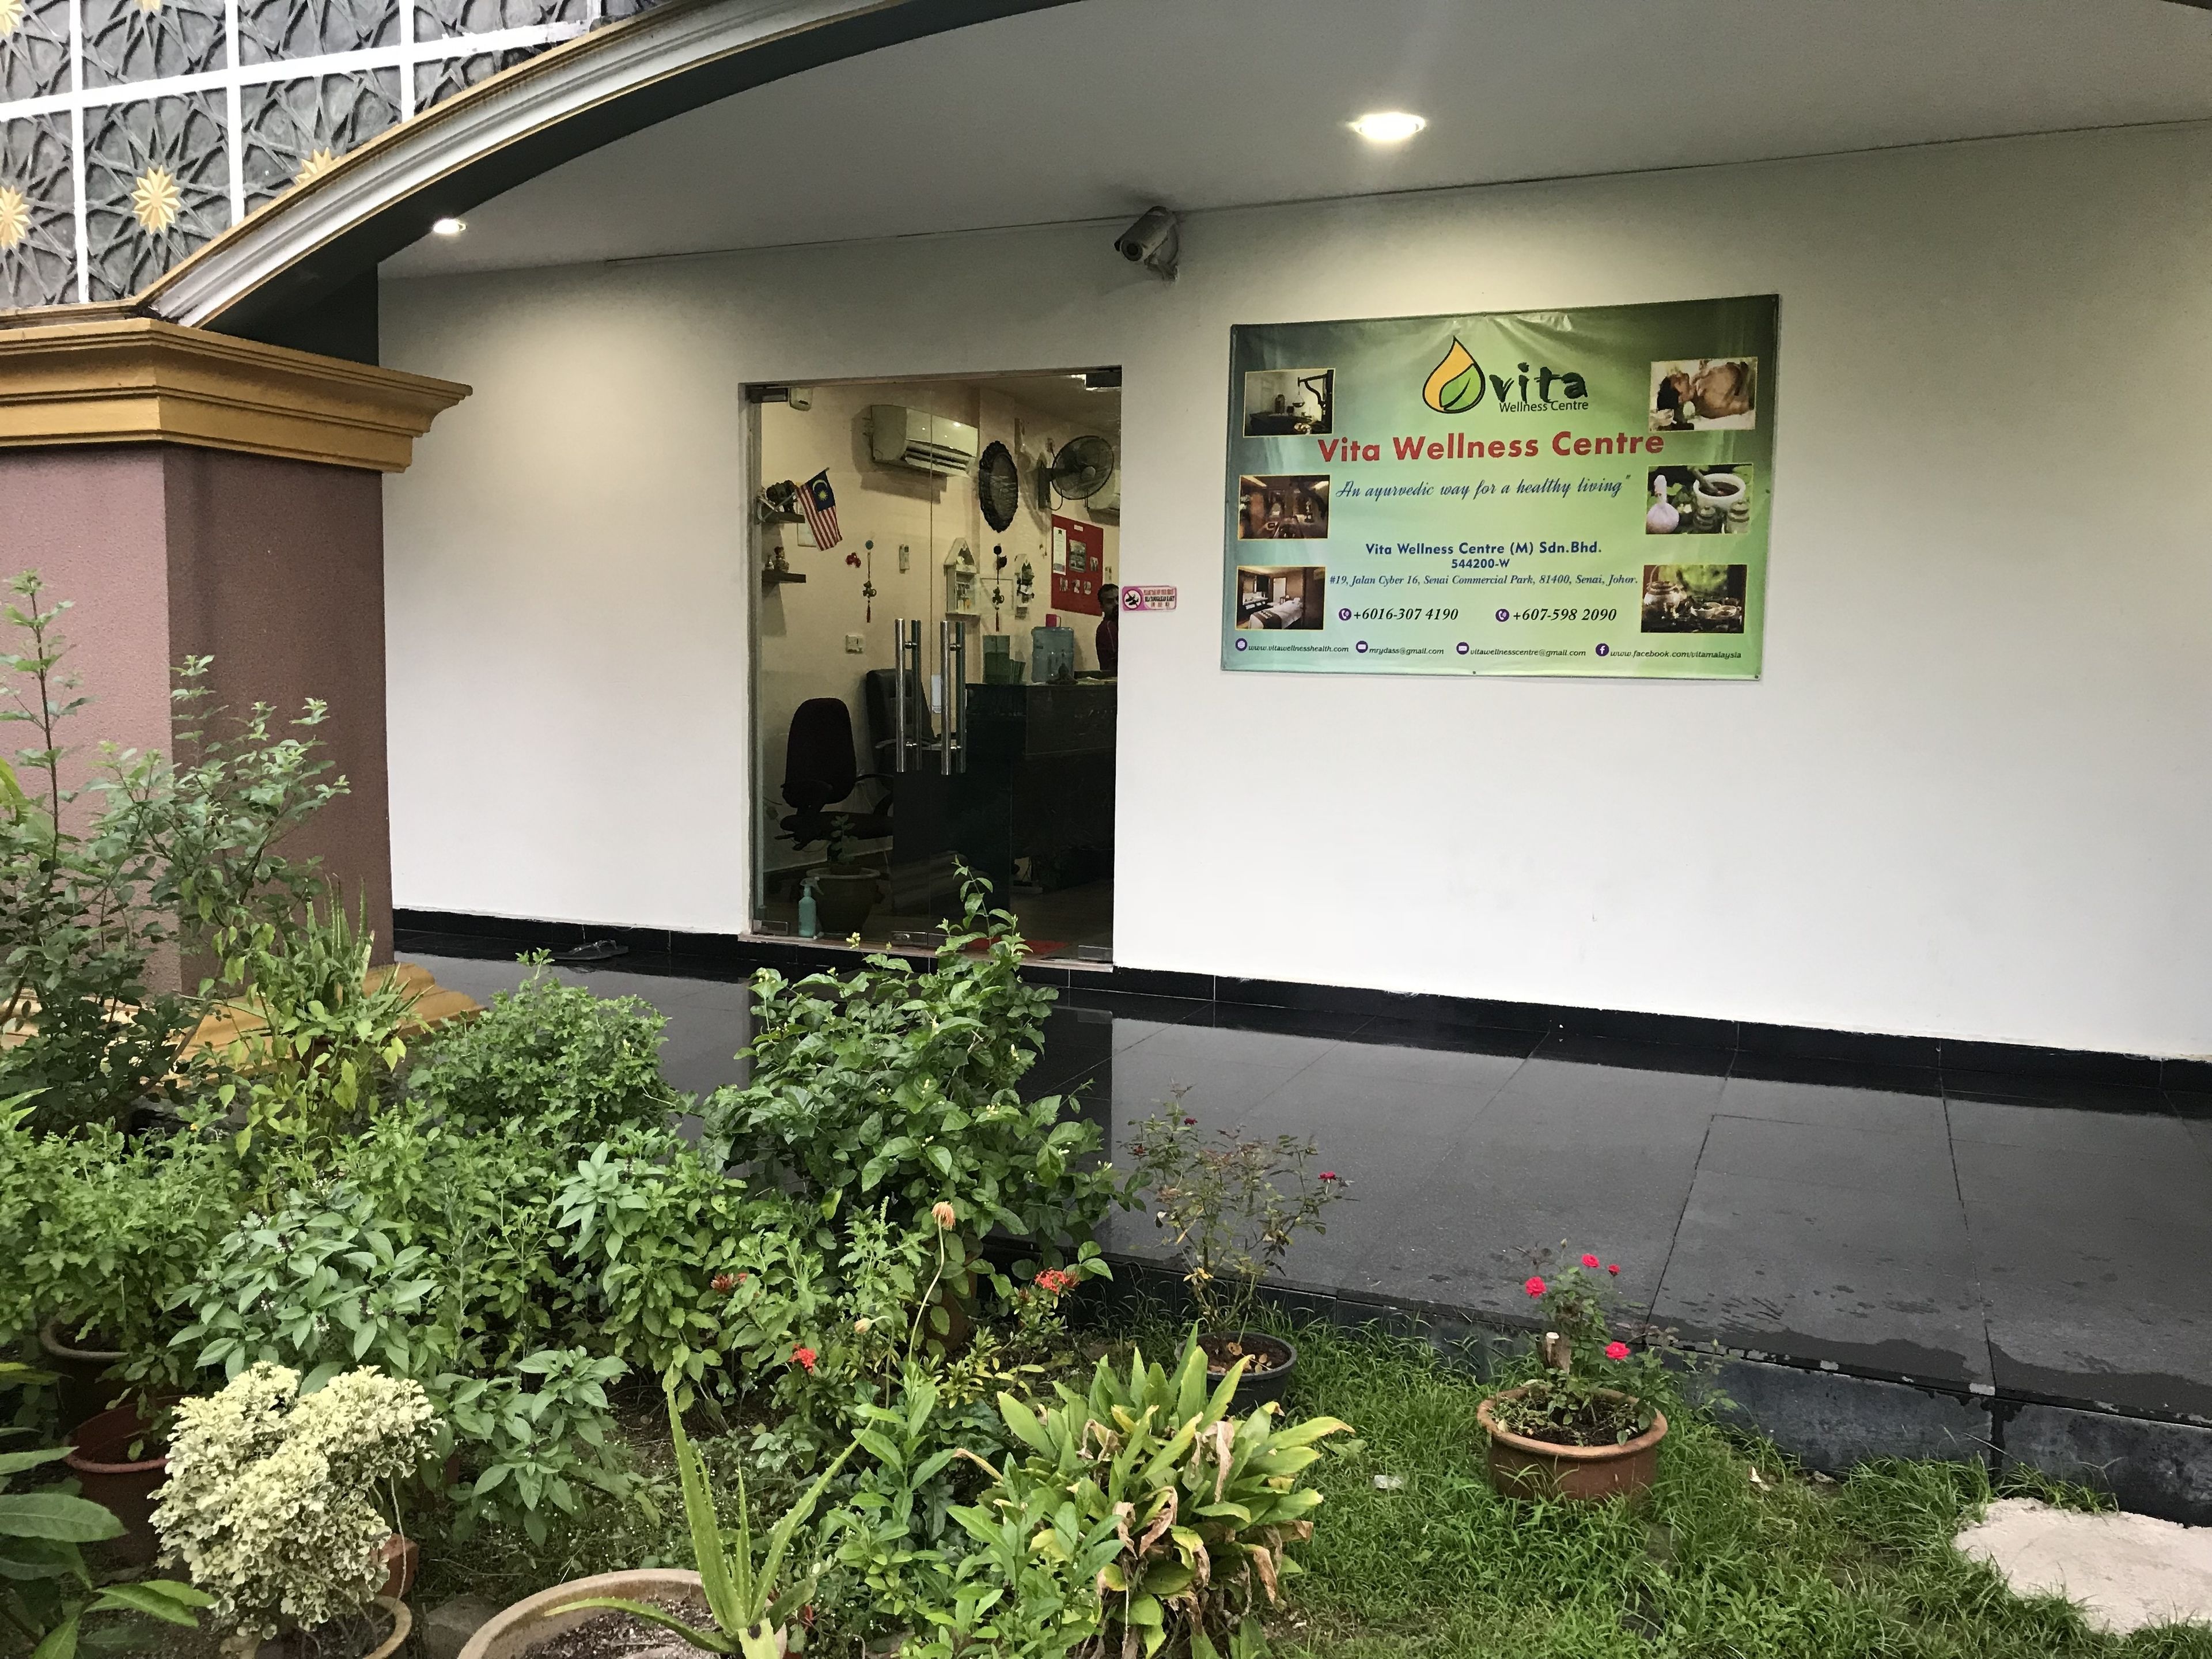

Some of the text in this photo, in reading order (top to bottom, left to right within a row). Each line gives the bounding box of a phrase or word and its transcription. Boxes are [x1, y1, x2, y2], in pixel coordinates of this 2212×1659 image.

[1489, 362, 1588, 403] vita
[1499, 400, 1589, 412] Wellness Centre
[1317, 431, 1664, 462] Vita Wellness Centre
[1335, 480, 1361, 497] An
[1365, 481, 1434, 502] ayurvedic
[1440, 483, 1470, 500] way
[1473, 479, 1497, 500] for
[1501, 484, 1510, 494] a
[1516, 478, 1571, 498] healthy
[1366, 541, 1602, 555] Vita Wellness Centre (M) Sdn.Bhd.
[1451, 558, 1510, 569] 544200-W
[1330, 574, 1638, 587] #19, Jalan Cyber 16, Senai Commercial Park, 81400, Senai, Johor.
[1354, 608, 1459, 620] +6016-307 4190
[1513, 608, 1617, 621] +607-598 2090
[1248, 645, 1349, 653] www.vitawellnesshealth.com
[1369, 647, 1444, 656] mrydass@gmail.com
[1469, 649, 1586, 657] vitawellnesscentre@gmail.com
[1610, 650, 1741, 660] www.facebook.com/vitamalaysia
